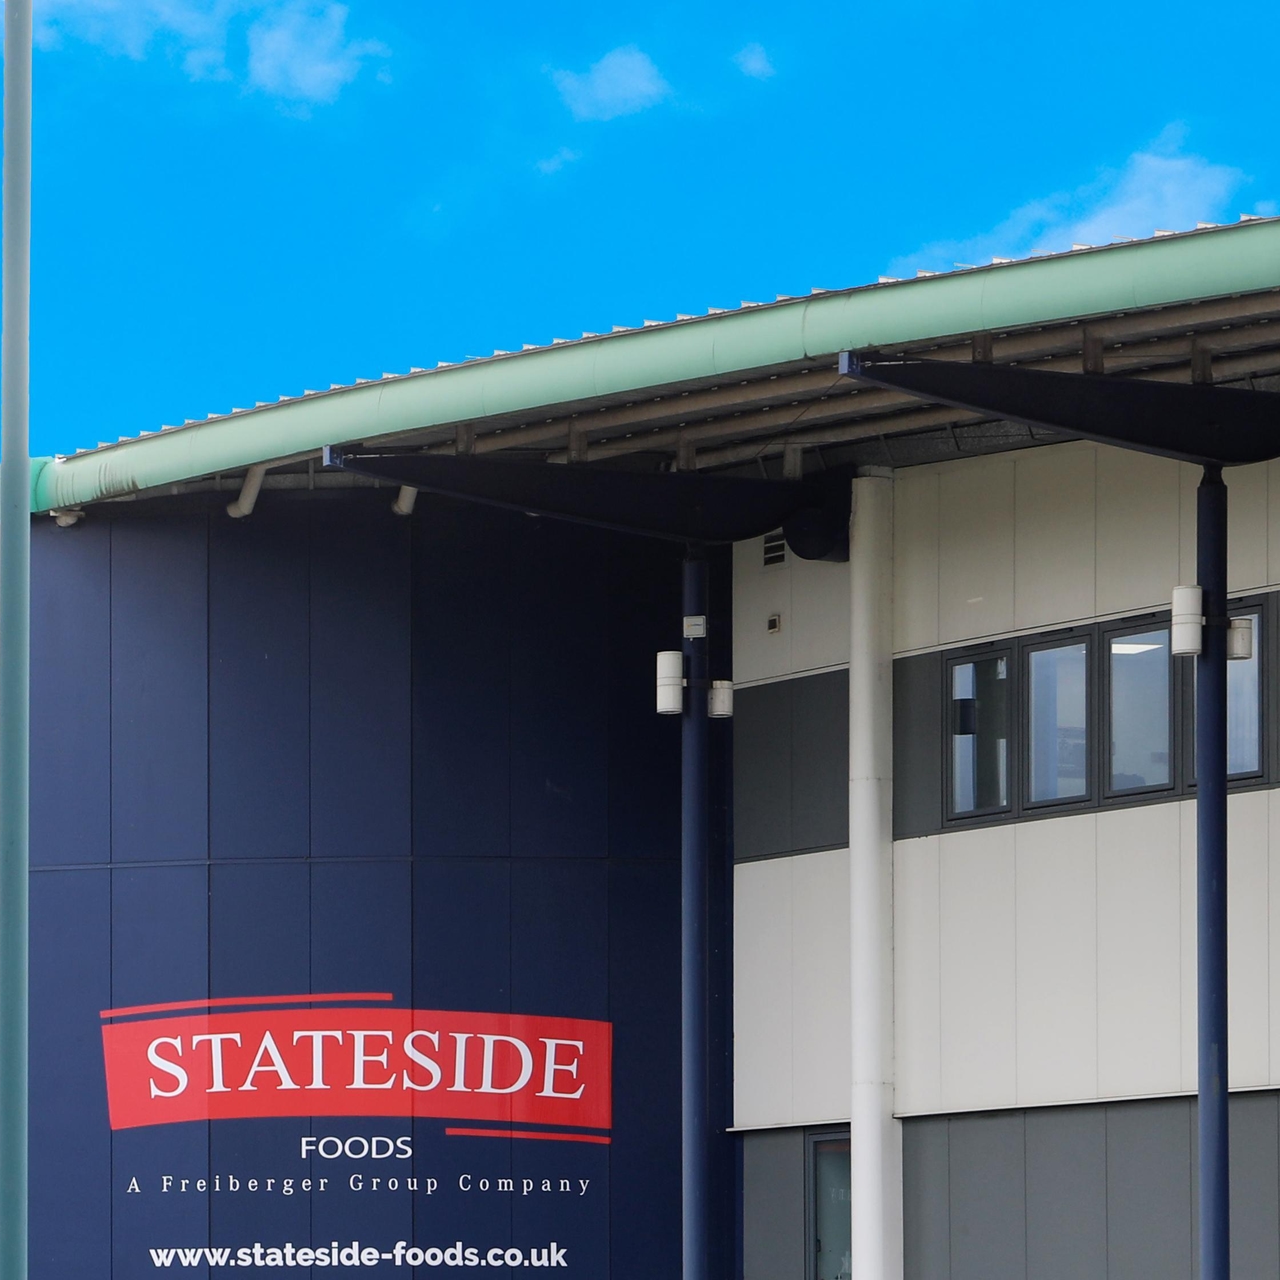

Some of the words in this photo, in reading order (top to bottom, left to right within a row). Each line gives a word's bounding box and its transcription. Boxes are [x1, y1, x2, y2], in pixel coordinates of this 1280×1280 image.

[146, 1029, 585, 1099] STATESIDE
[301, 1137, 413, 1158] FOODS
[127, 1177, 140, 1193] A
[162, 1175, 329, 1194] Freiberger
[349, 1174, 439, 1194] Group
[459, 1174, 591, 1194] Company
[149, 1241, 568, 1267] www.stateside-foods.co.uk
